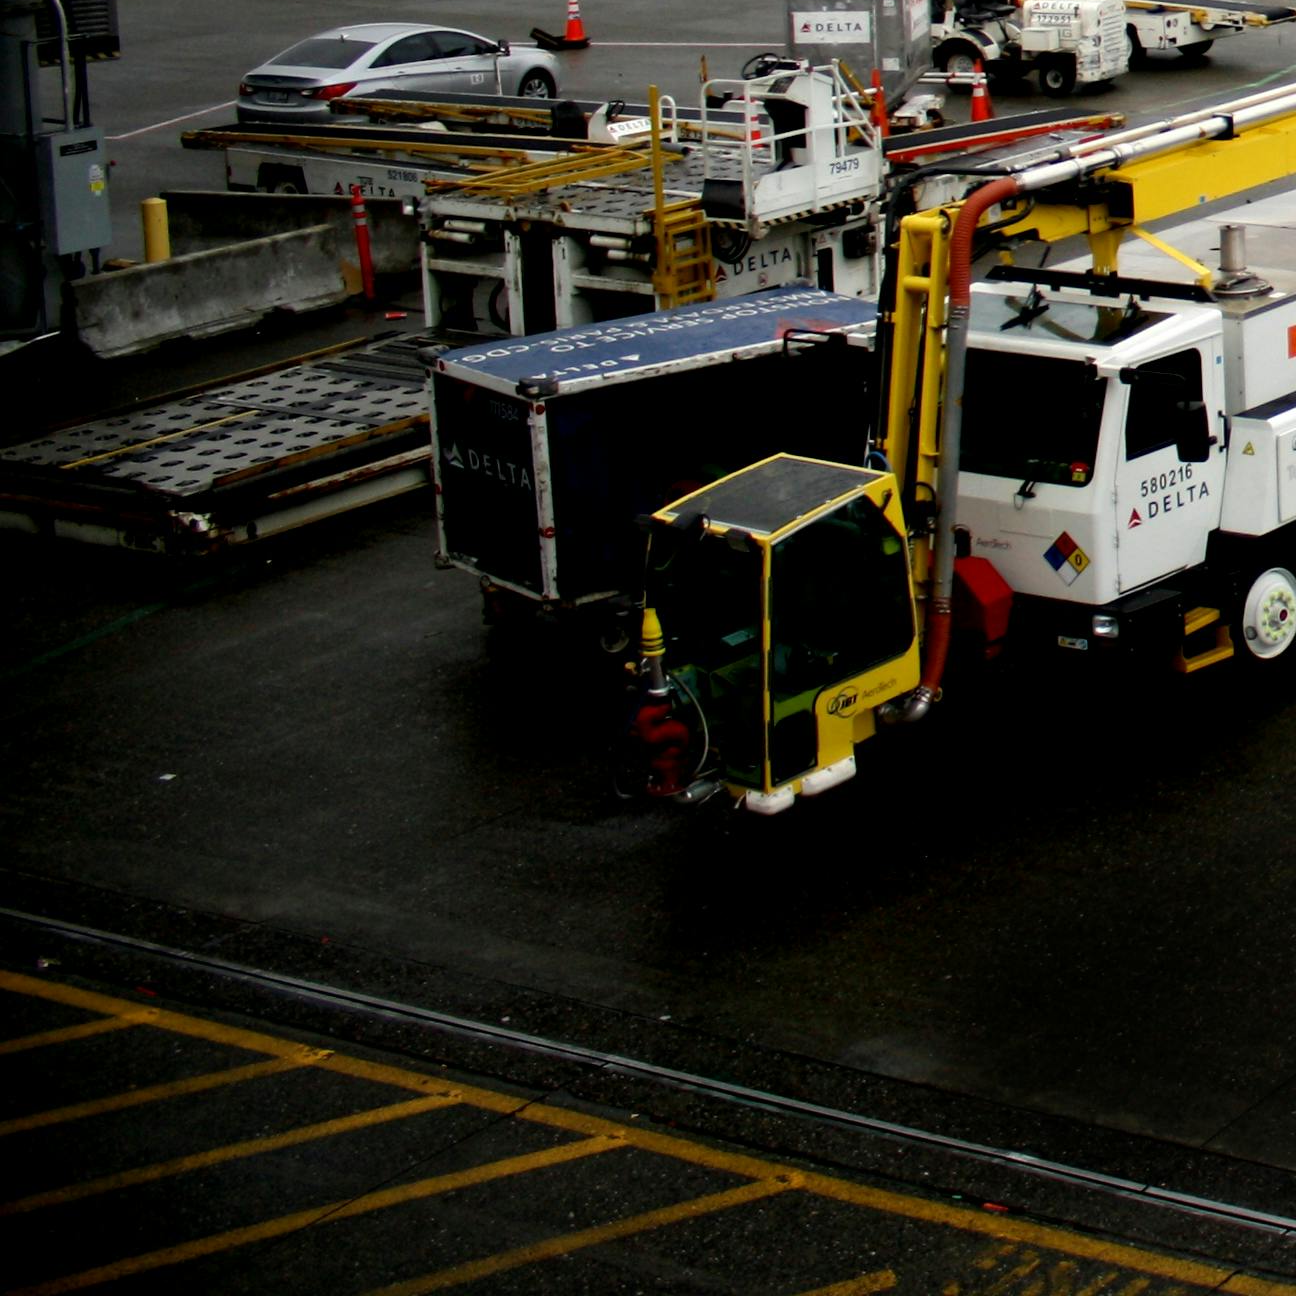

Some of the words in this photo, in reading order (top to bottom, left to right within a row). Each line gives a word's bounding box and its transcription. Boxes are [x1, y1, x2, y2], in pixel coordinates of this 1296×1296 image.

[815, 22, 863, 33] DELTA
[617, 118, 651, 131] DELTA
[829, 157, 860, 175] 79479
[733, 247, 792, 276] DELTA
[721, 295, 852, 320] NONSTOP
[598, 318, 714, 342] SERVICE
[550, 340, 597, 353] TO
[530, 358, 619, 380] DELTA
[467, 447, 533, 491] DELTA
[1140, 463, 1193, 498] 580216
[1148, 481, 1210, 519] DELTA
[1074, 553, 1083, 567] 0
[861, 677, 898, 699] AeroTech
